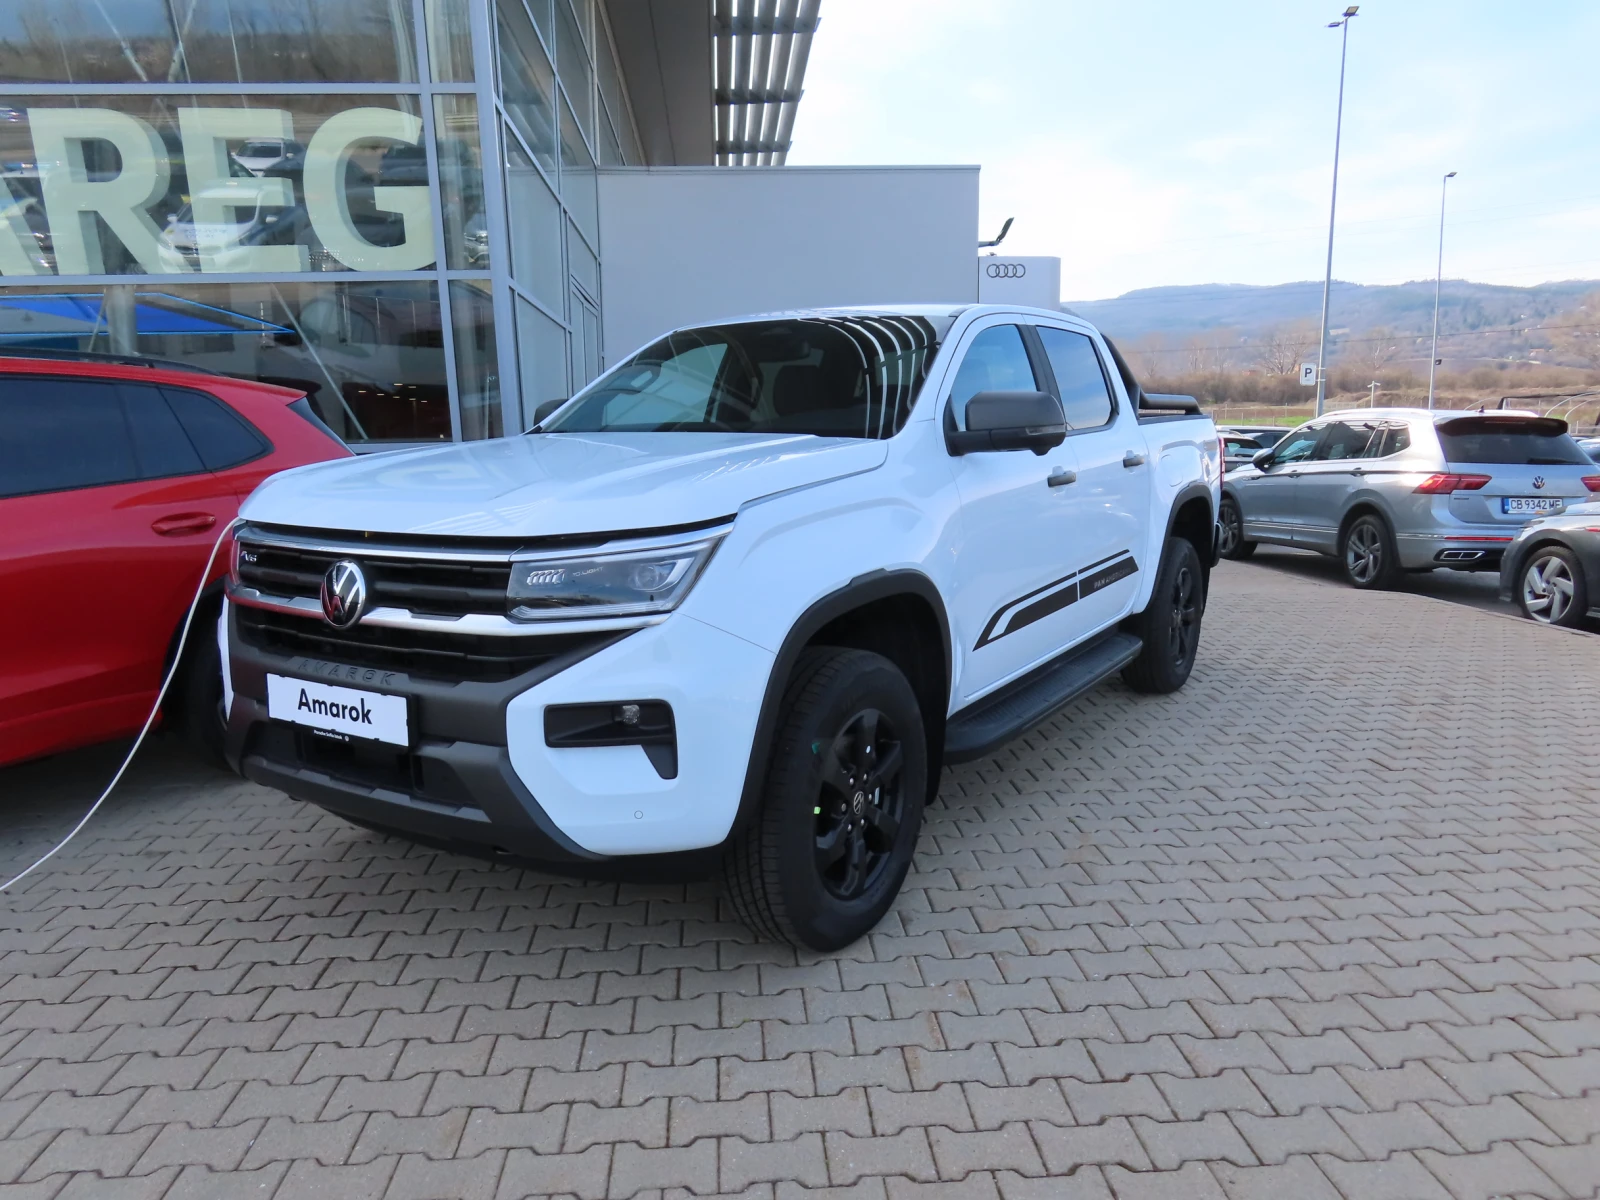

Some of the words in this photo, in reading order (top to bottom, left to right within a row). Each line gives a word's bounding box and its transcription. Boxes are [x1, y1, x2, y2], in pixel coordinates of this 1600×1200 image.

[0, 107, 437, 275] REG
[1304, 367, 1313, 378] P
[1510, 499, 1523, 509] CB
[1525, 499, 1547, 509] 9342
[298, 659, 396, 686] AMAROK
[298, 688, 372, 725] Amarok
